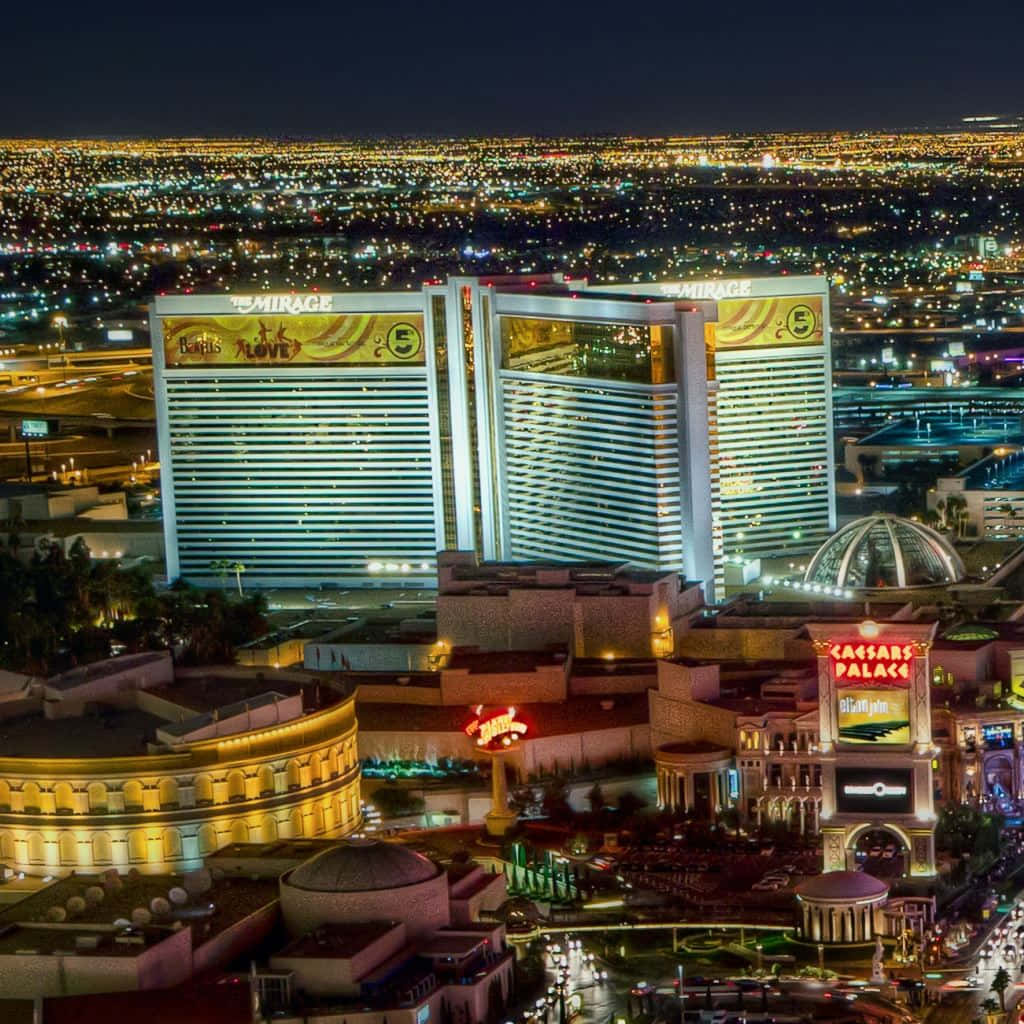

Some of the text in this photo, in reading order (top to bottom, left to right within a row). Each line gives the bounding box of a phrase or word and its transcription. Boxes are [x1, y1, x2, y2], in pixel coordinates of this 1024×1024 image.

[676, 280, 751, 299] MIRAGE
[243, 294, 333, 315] MIRAGE
[246, 342, 291, 359] LOVE
[830, 644, 913, 661] CAESARS
[835, 662, 909, 679] PALACE
